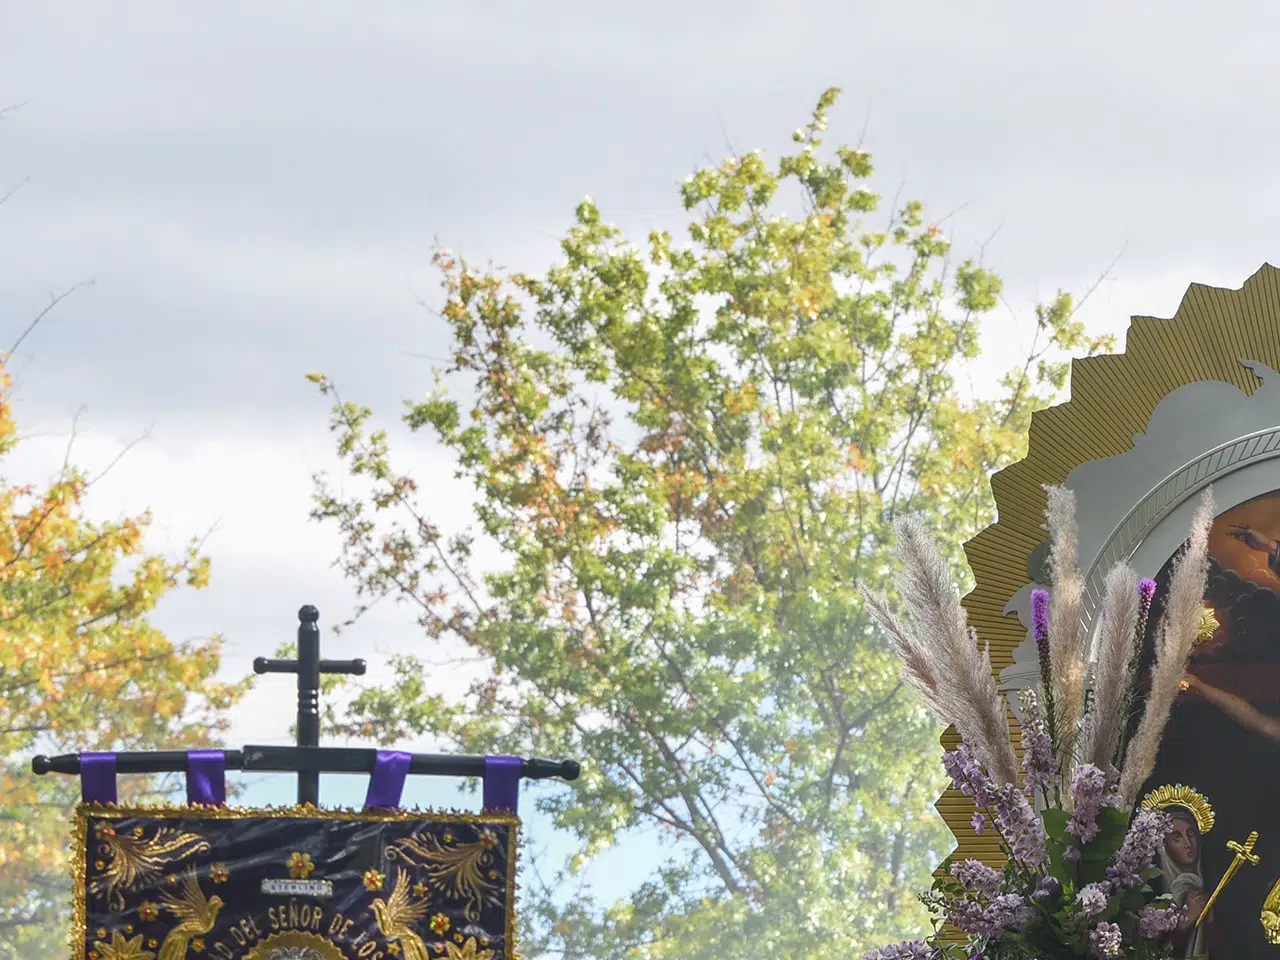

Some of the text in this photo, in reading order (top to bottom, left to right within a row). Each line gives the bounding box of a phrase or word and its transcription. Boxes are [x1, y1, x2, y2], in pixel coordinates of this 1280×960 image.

[270, 883, 323, 892] STERLING
[229, 914, 263, 945] DEL
[268, 898, 323, 930] SEÑOR
[328, 913, 355, 940] DE
